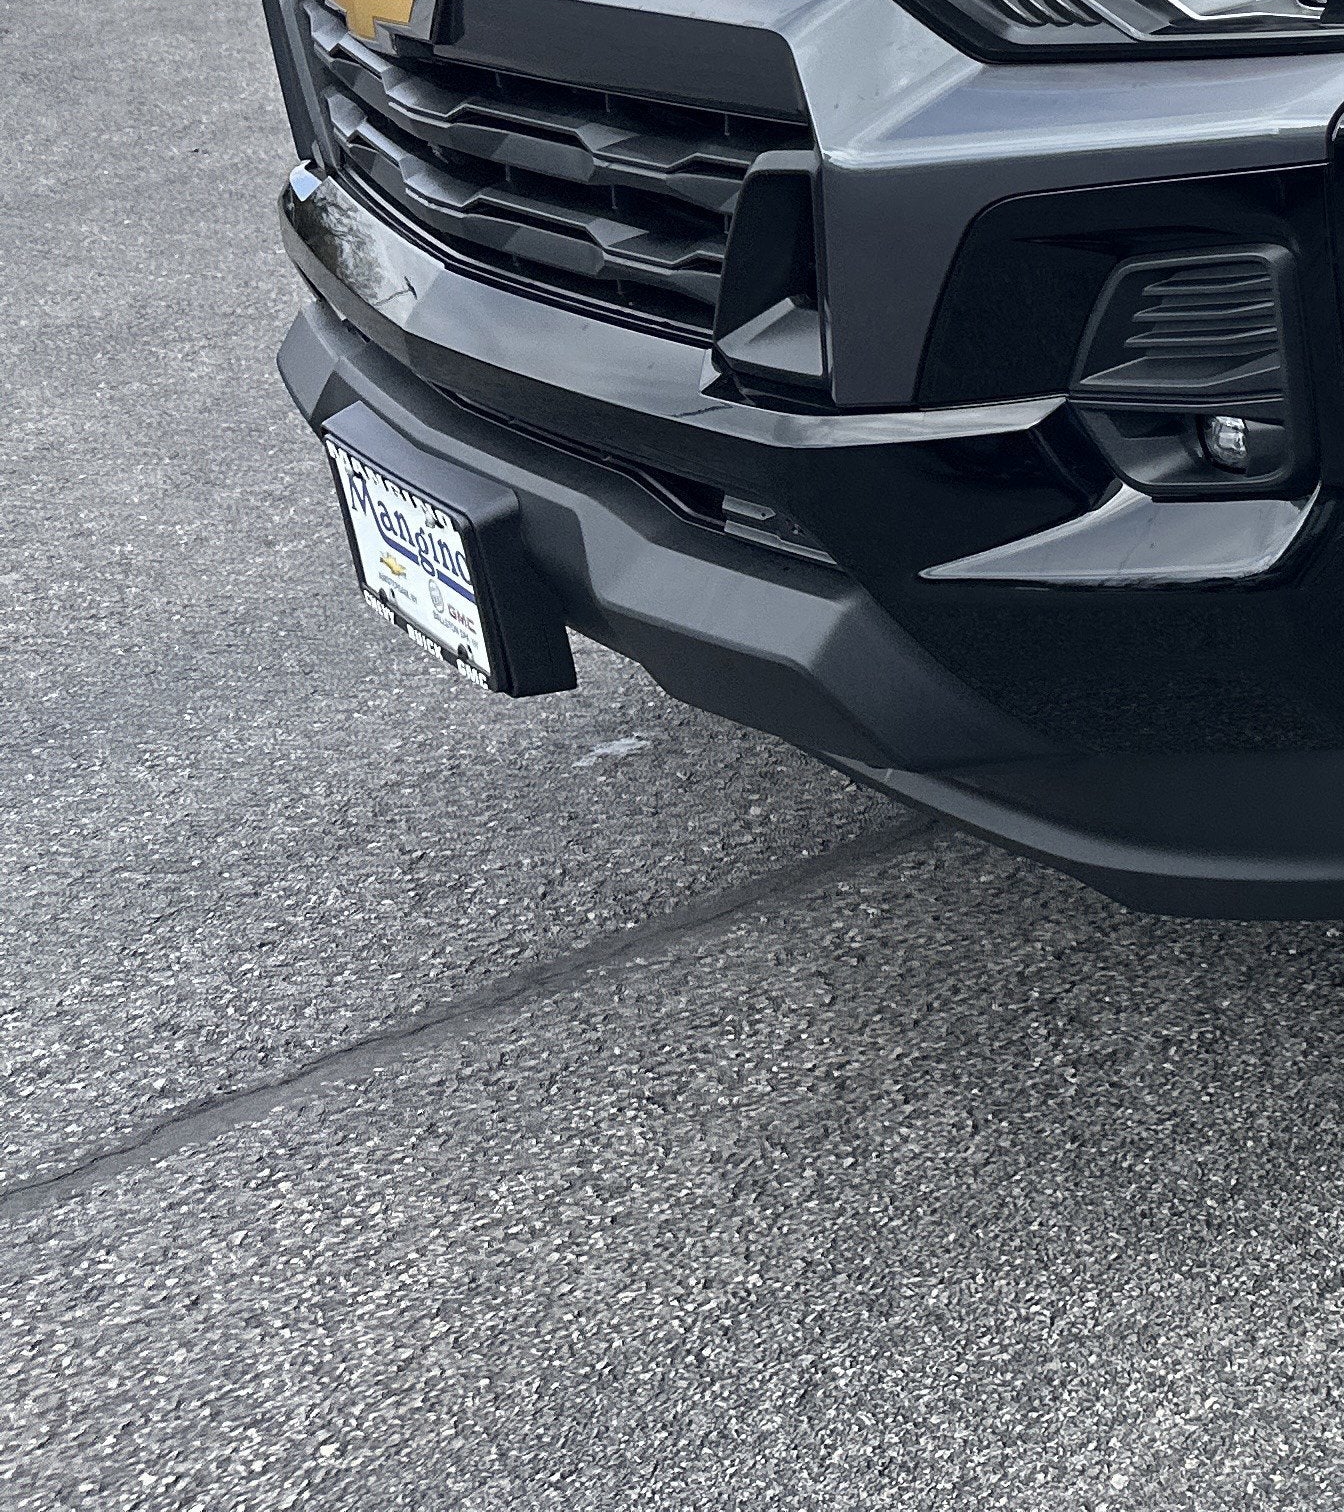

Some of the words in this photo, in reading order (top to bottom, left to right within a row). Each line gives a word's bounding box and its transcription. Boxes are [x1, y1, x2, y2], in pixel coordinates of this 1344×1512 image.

[348, 475, 473, 587] Mangino
[363, 590, 395, 624] CHEVY
[447, 604, 477, 634] GMC
[406, 623, 444, 662] BUICK
[456, 658, 489, 690] GMC
